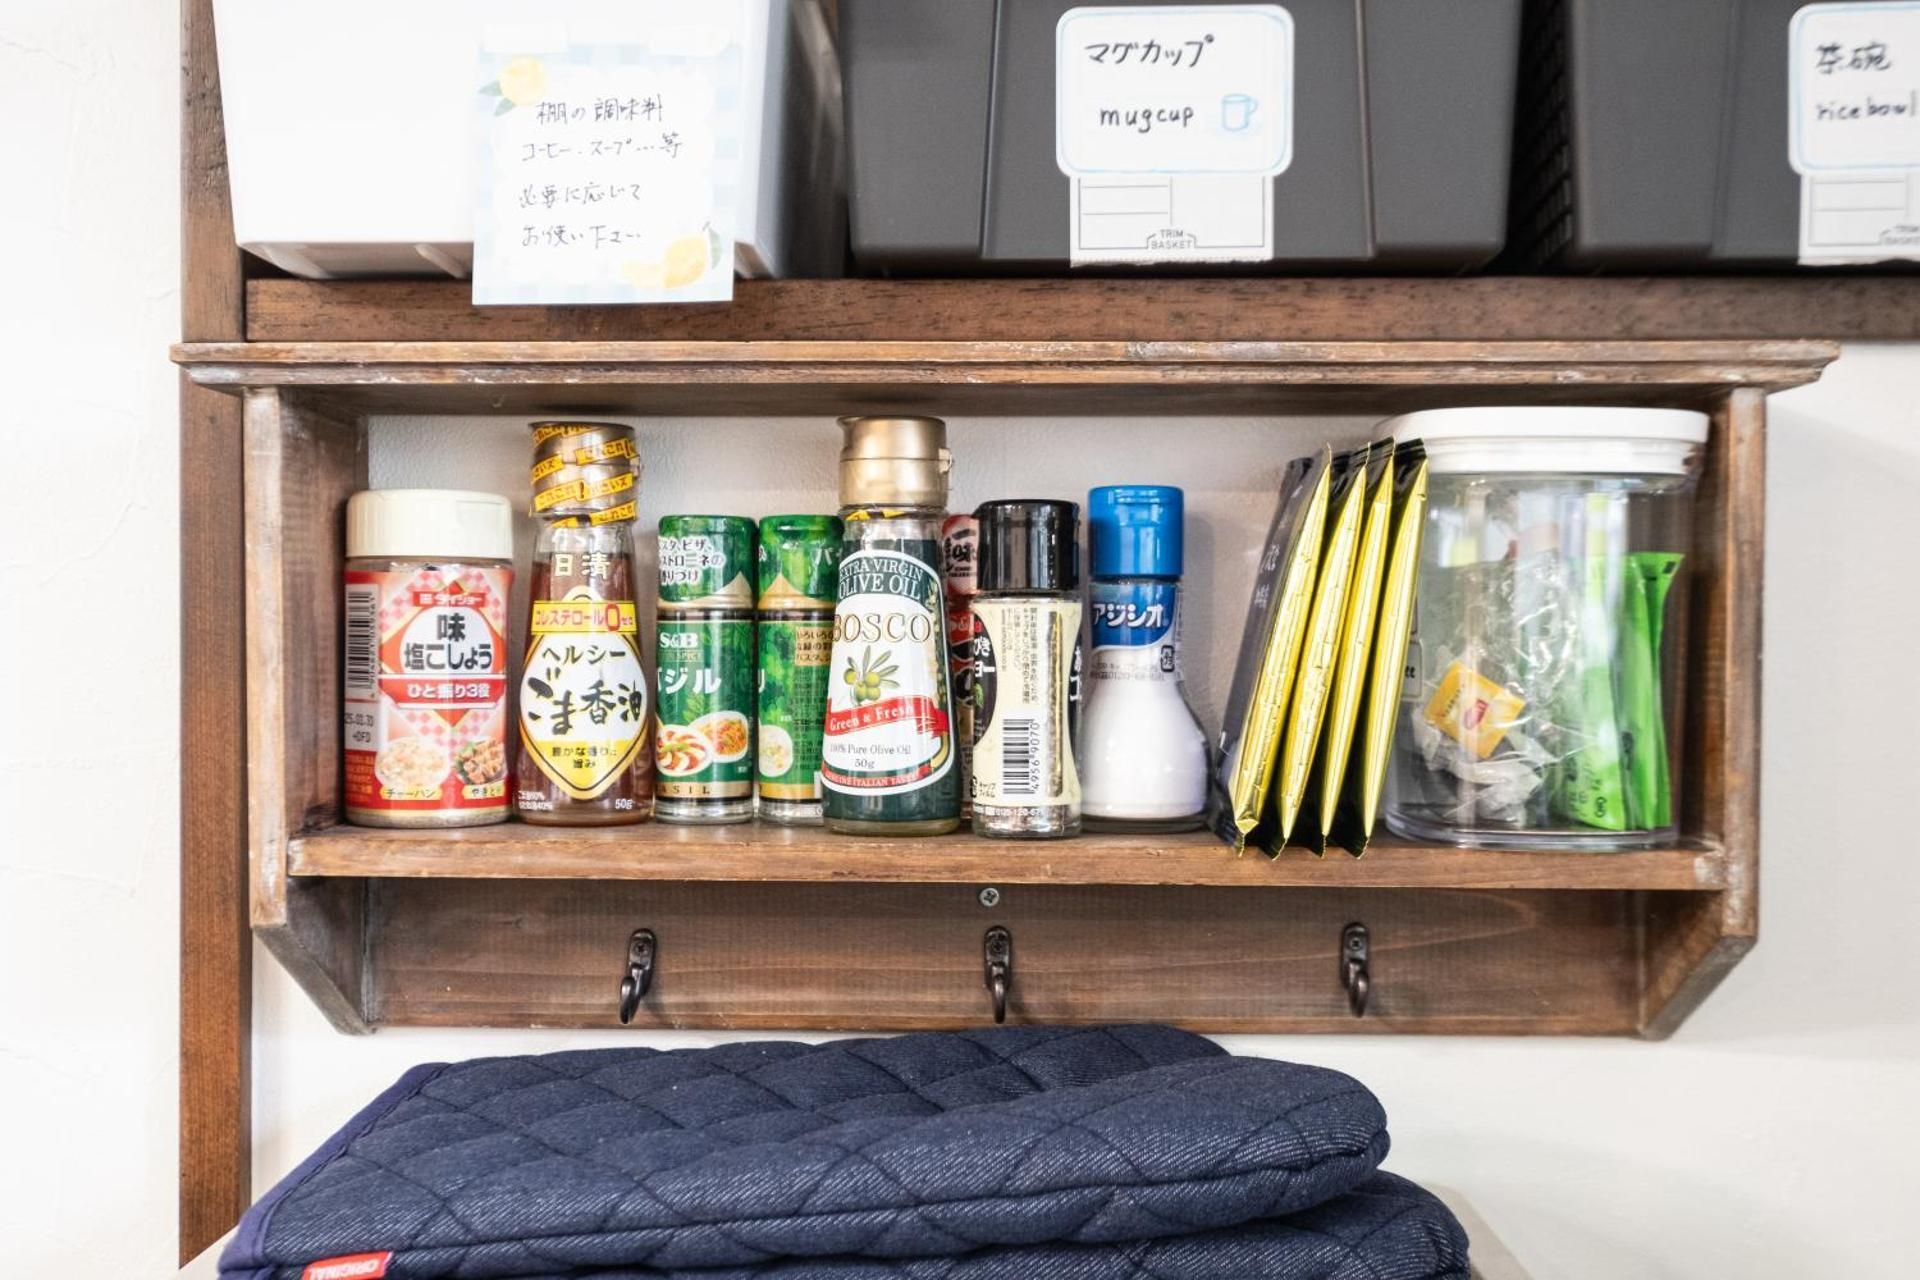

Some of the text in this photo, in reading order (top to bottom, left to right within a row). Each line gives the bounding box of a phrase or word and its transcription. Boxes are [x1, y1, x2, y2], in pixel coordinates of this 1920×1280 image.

[1084, 33, 1215, 67] マグカップ
[535, 93, 663, 124] 棚の調味料
[1867, 88, 1916, 117] bowl
[519, 180, 641, 209] 必要に応じて
[1151, 240, 1192, 250] BASKET
[1159, 229, 1184, 239] TRIM
[555, 553, 610, 579] 日清
[873, 558, 924, 582] VIRGIN
[839, 573, 921, 601] OLIVE OIL
[436, 613, 466, 642] 味
[833, 613, 931, 643] BOSCO
[1093, 603, 1163, 628] アジシオ
[659, 632, 698, 648] S&B
[404, 643, 493, 671] 塩こしょう
[542, 645, 626, 665] ヘルシー
[528, 667, 642, 735] ごま香油
[829, 704, 914, 732] Green & Fresh
[848, 744, 867, 755] Pure
[869, 743, 895, 755] Olive
[854, 758, 875, 769] 50g
[853, 776, 887, 787] ITALIAN
[615, 798, 634, 810] 50g
